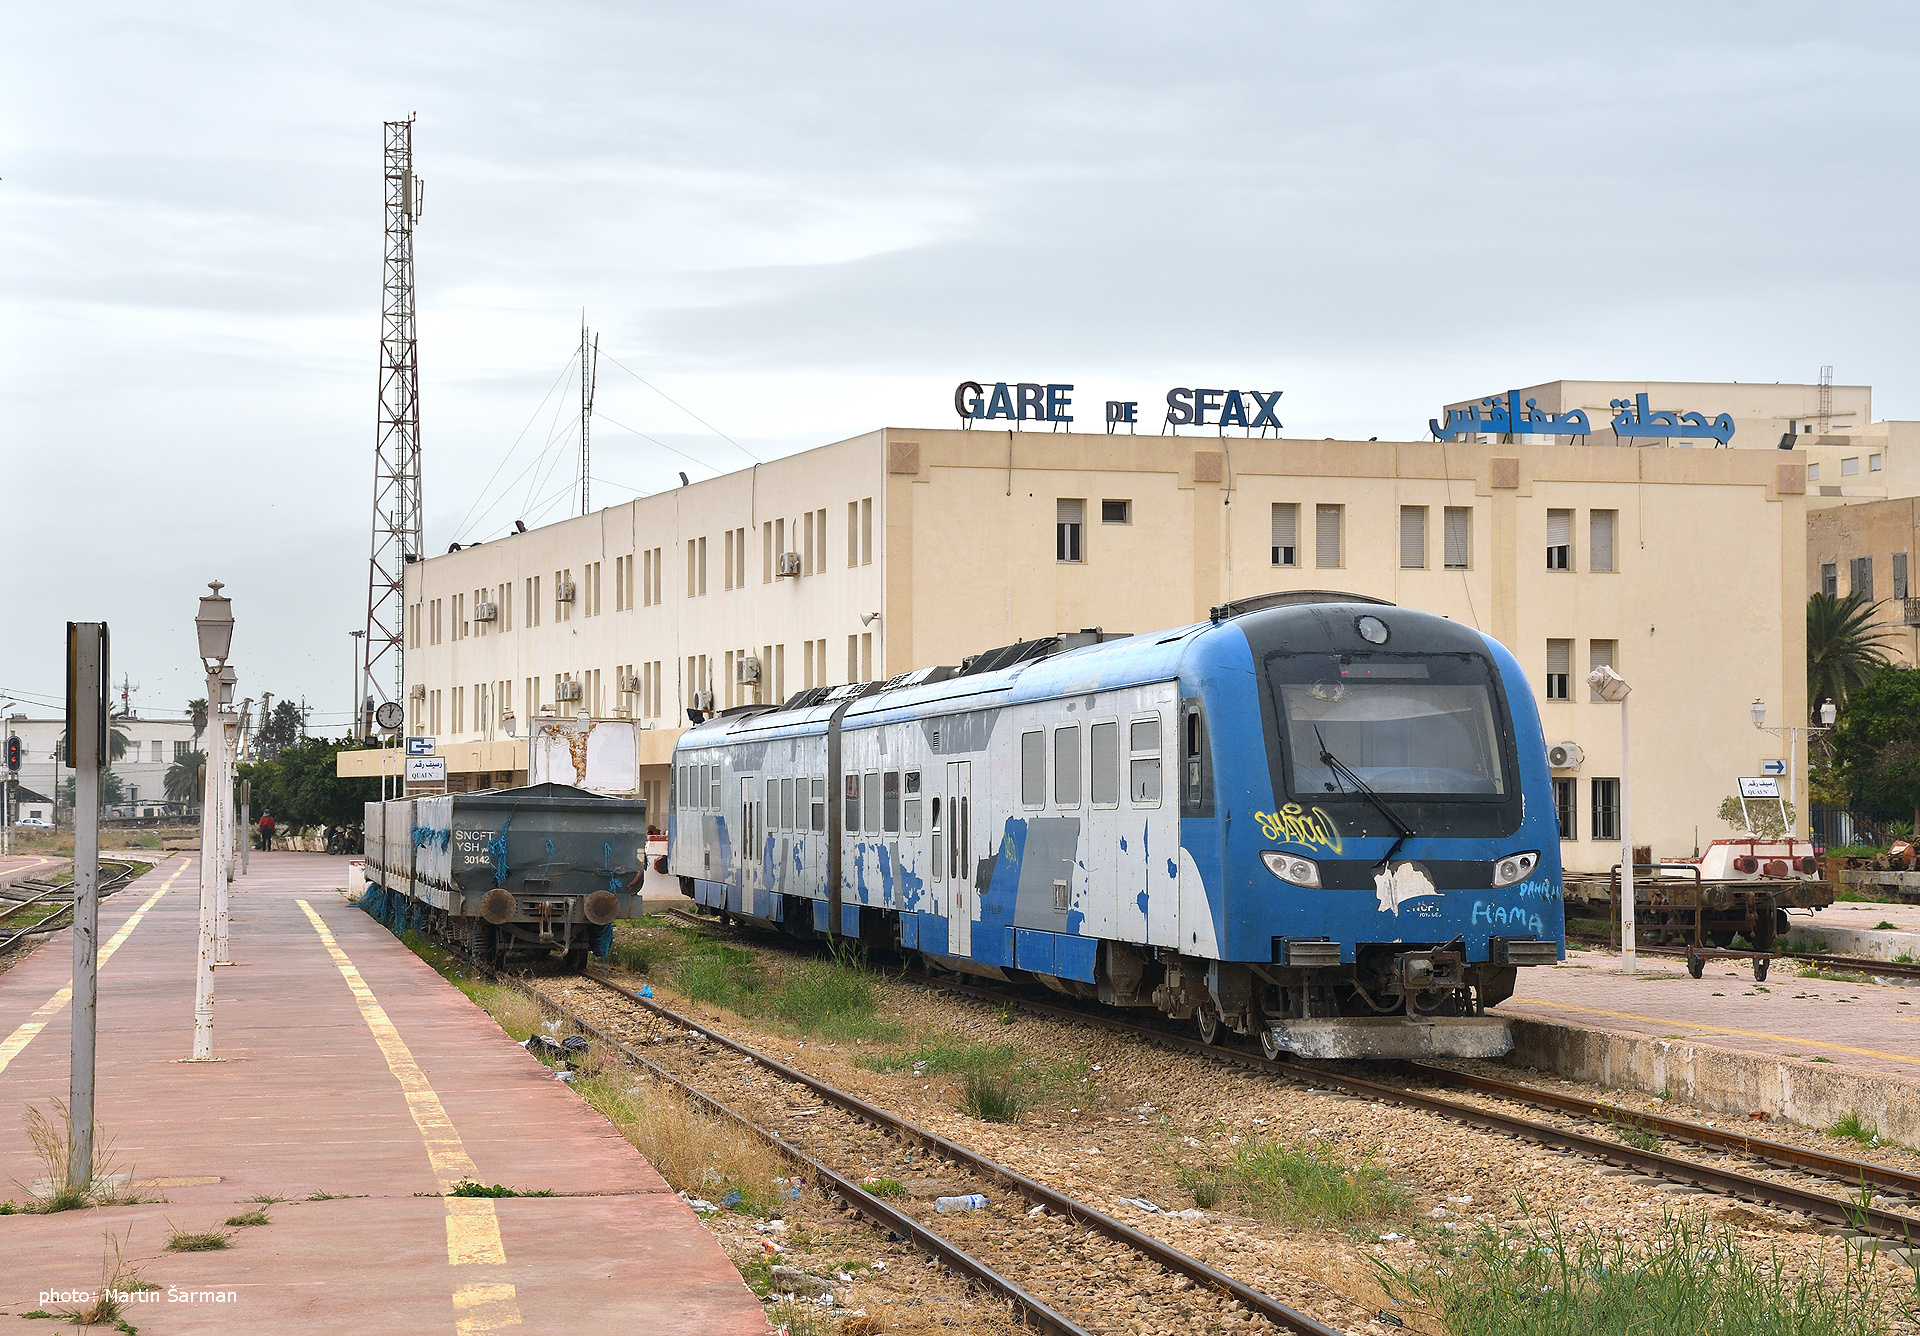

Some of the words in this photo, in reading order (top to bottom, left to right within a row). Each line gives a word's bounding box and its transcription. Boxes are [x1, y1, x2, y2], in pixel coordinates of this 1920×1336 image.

[955, 381, 1074, 422] GARE
[1106, 401, 1138, 423] DE
[1166, 387, 1283, 428] SFAX
[1429, 389, 1591, 440] صفاقس
[1610, 392, 1736, 445] محطة
[413, 760, 425, 769] رقم
[425, 760, 443, 769] رصيف
[455, 830, 495, 840] SNCFT
[456, 842, 480, 852] YSH
[464, 855, 490, 864] 30142
[1472, 900, 1543, 934] HAMA
